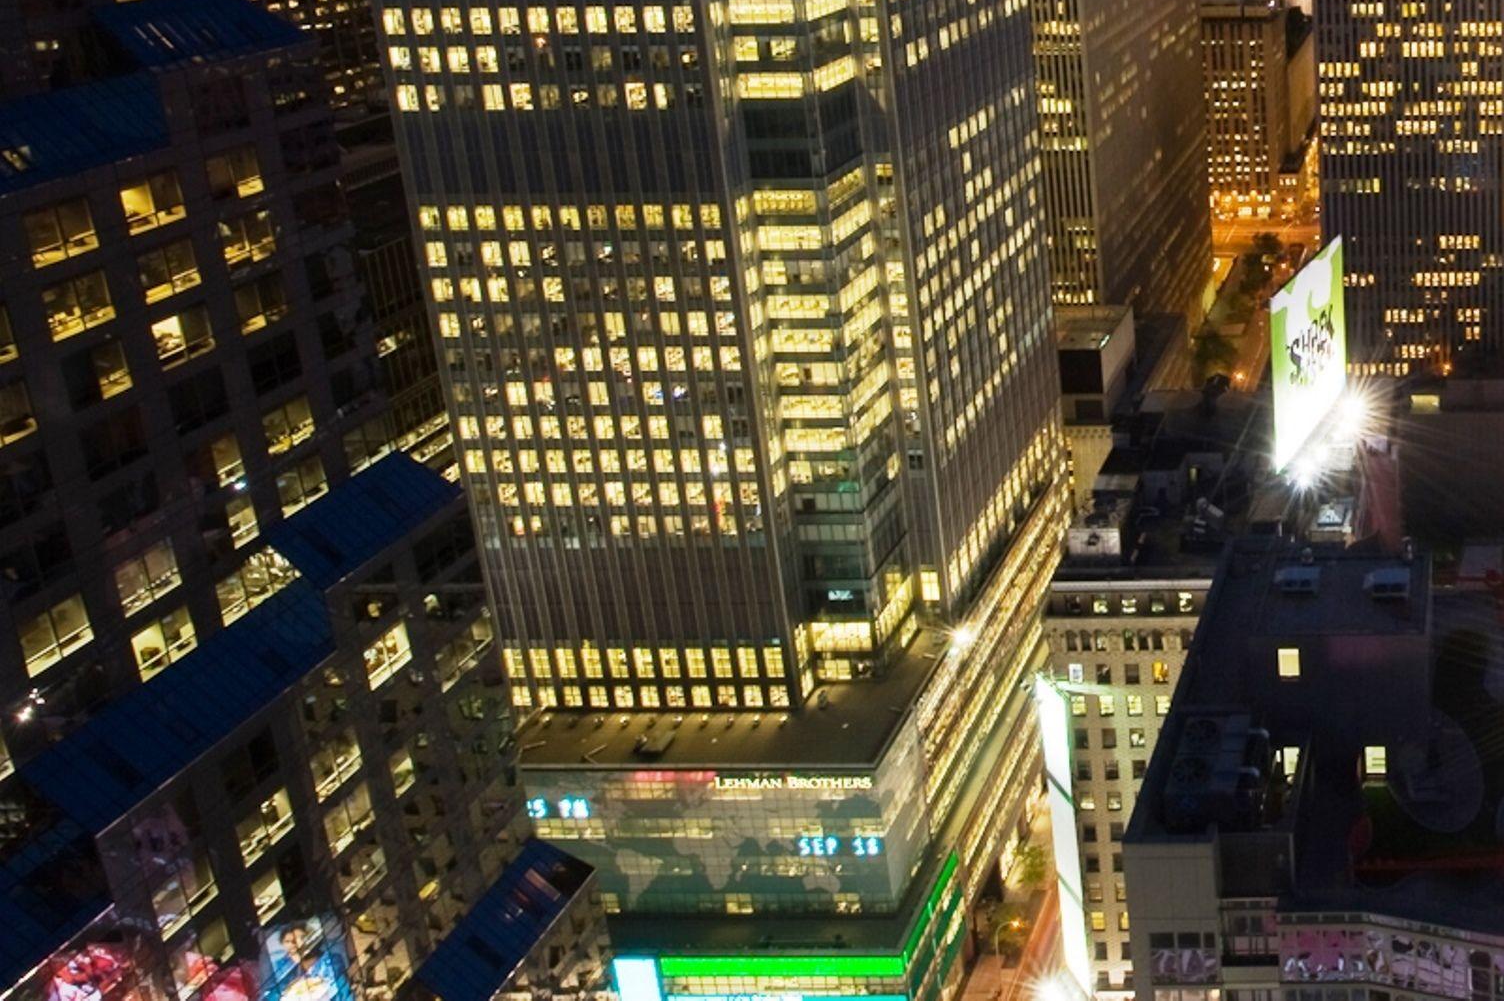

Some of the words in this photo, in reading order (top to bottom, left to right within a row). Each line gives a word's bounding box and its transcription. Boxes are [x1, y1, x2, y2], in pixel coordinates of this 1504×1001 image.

[714, 776, 782, 789] LEHMAN
[787, 776, 873, 789] BROTHERS
[798, 837, 839, 856] SEP
